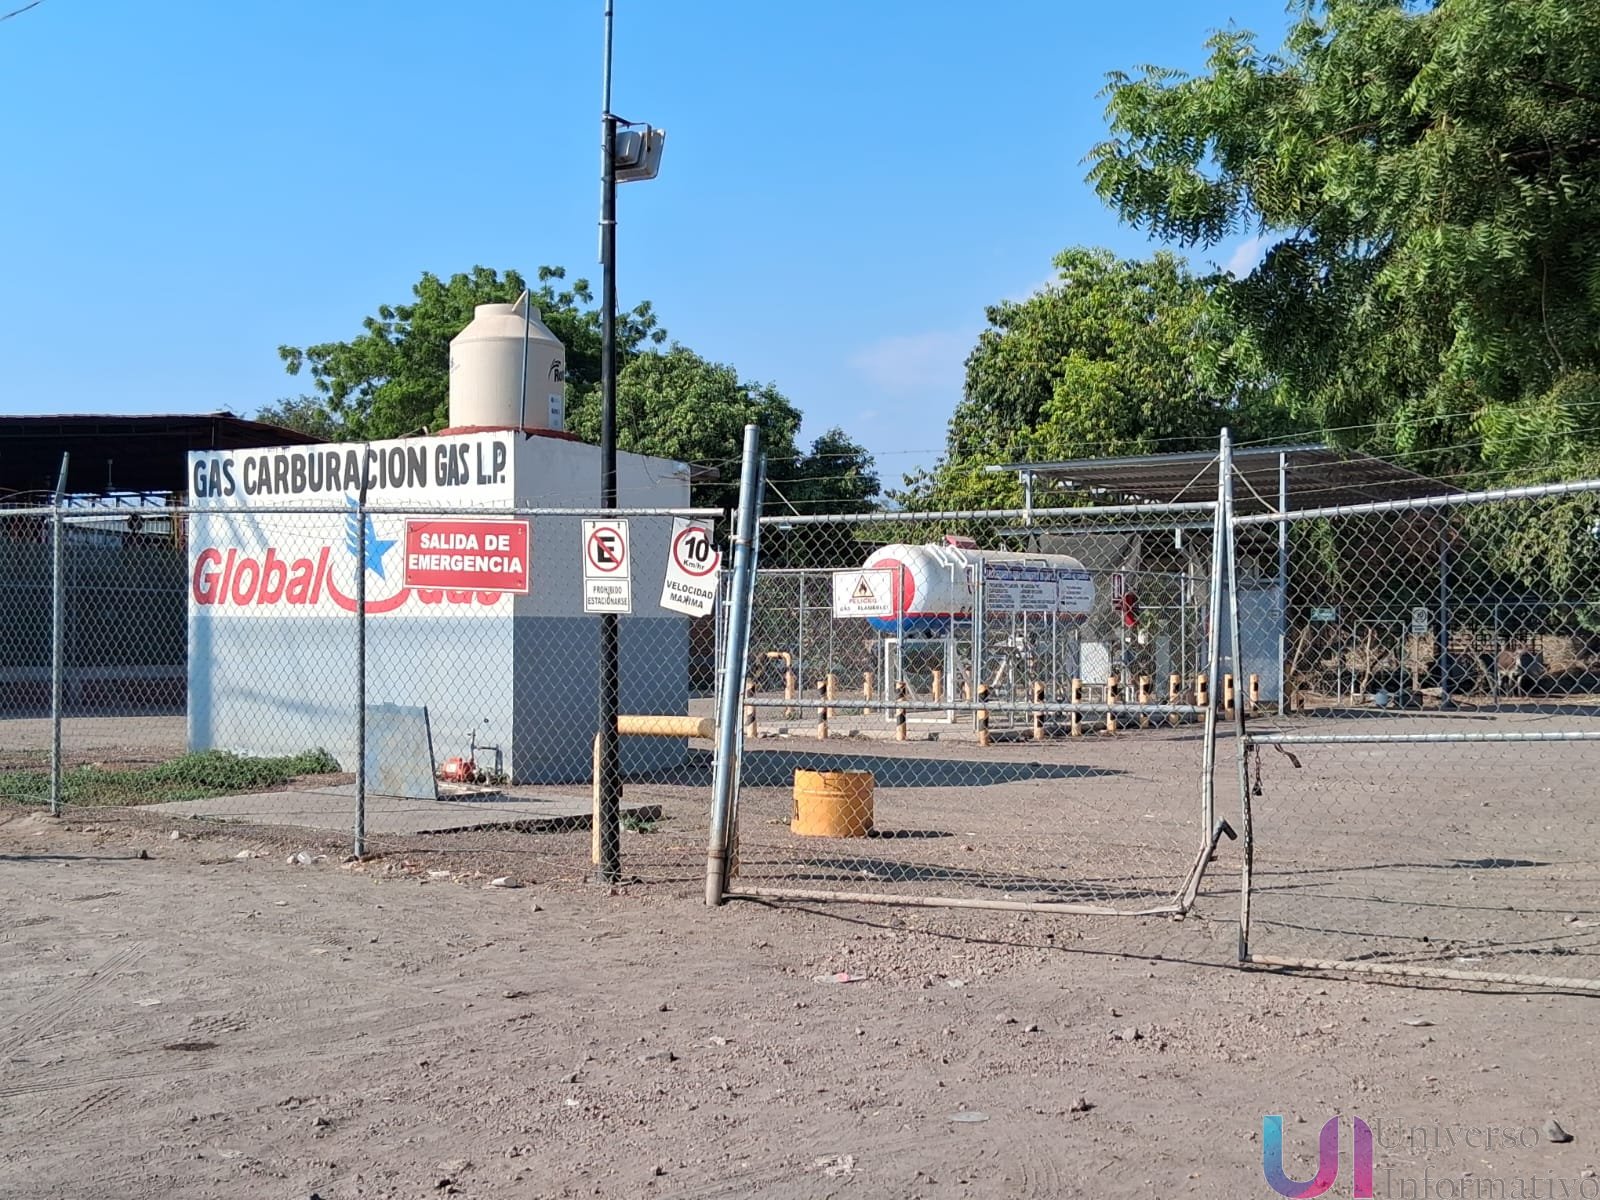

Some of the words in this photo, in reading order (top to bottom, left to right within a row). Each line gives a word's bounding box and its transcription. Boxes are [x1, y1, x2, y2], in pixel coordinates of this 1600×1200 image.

[193, 458, 236, 498] GAS
[243, 445, 427, 496] CARBURACION
[435, 443, 470, 486] GAS
[476, 441, 507, 485] L.P.
[420, 533, 479, 550] SALIDA
[484, 534, 511, 551] DE
[684, 536, 709, 562] 10
[408, 554, 523, 573] EMERGENCIA
[683, 559, 705, 570] Km/hr
[192, 546, 331, 606] Global
[593, 585, 622, 595] PROHIBIDO
[666, 580, 713, 600] VELOCIDAD
[587, 596, 628, 606] ESTACIONARSE
[669, 593, 703, 609] MAXIMA
